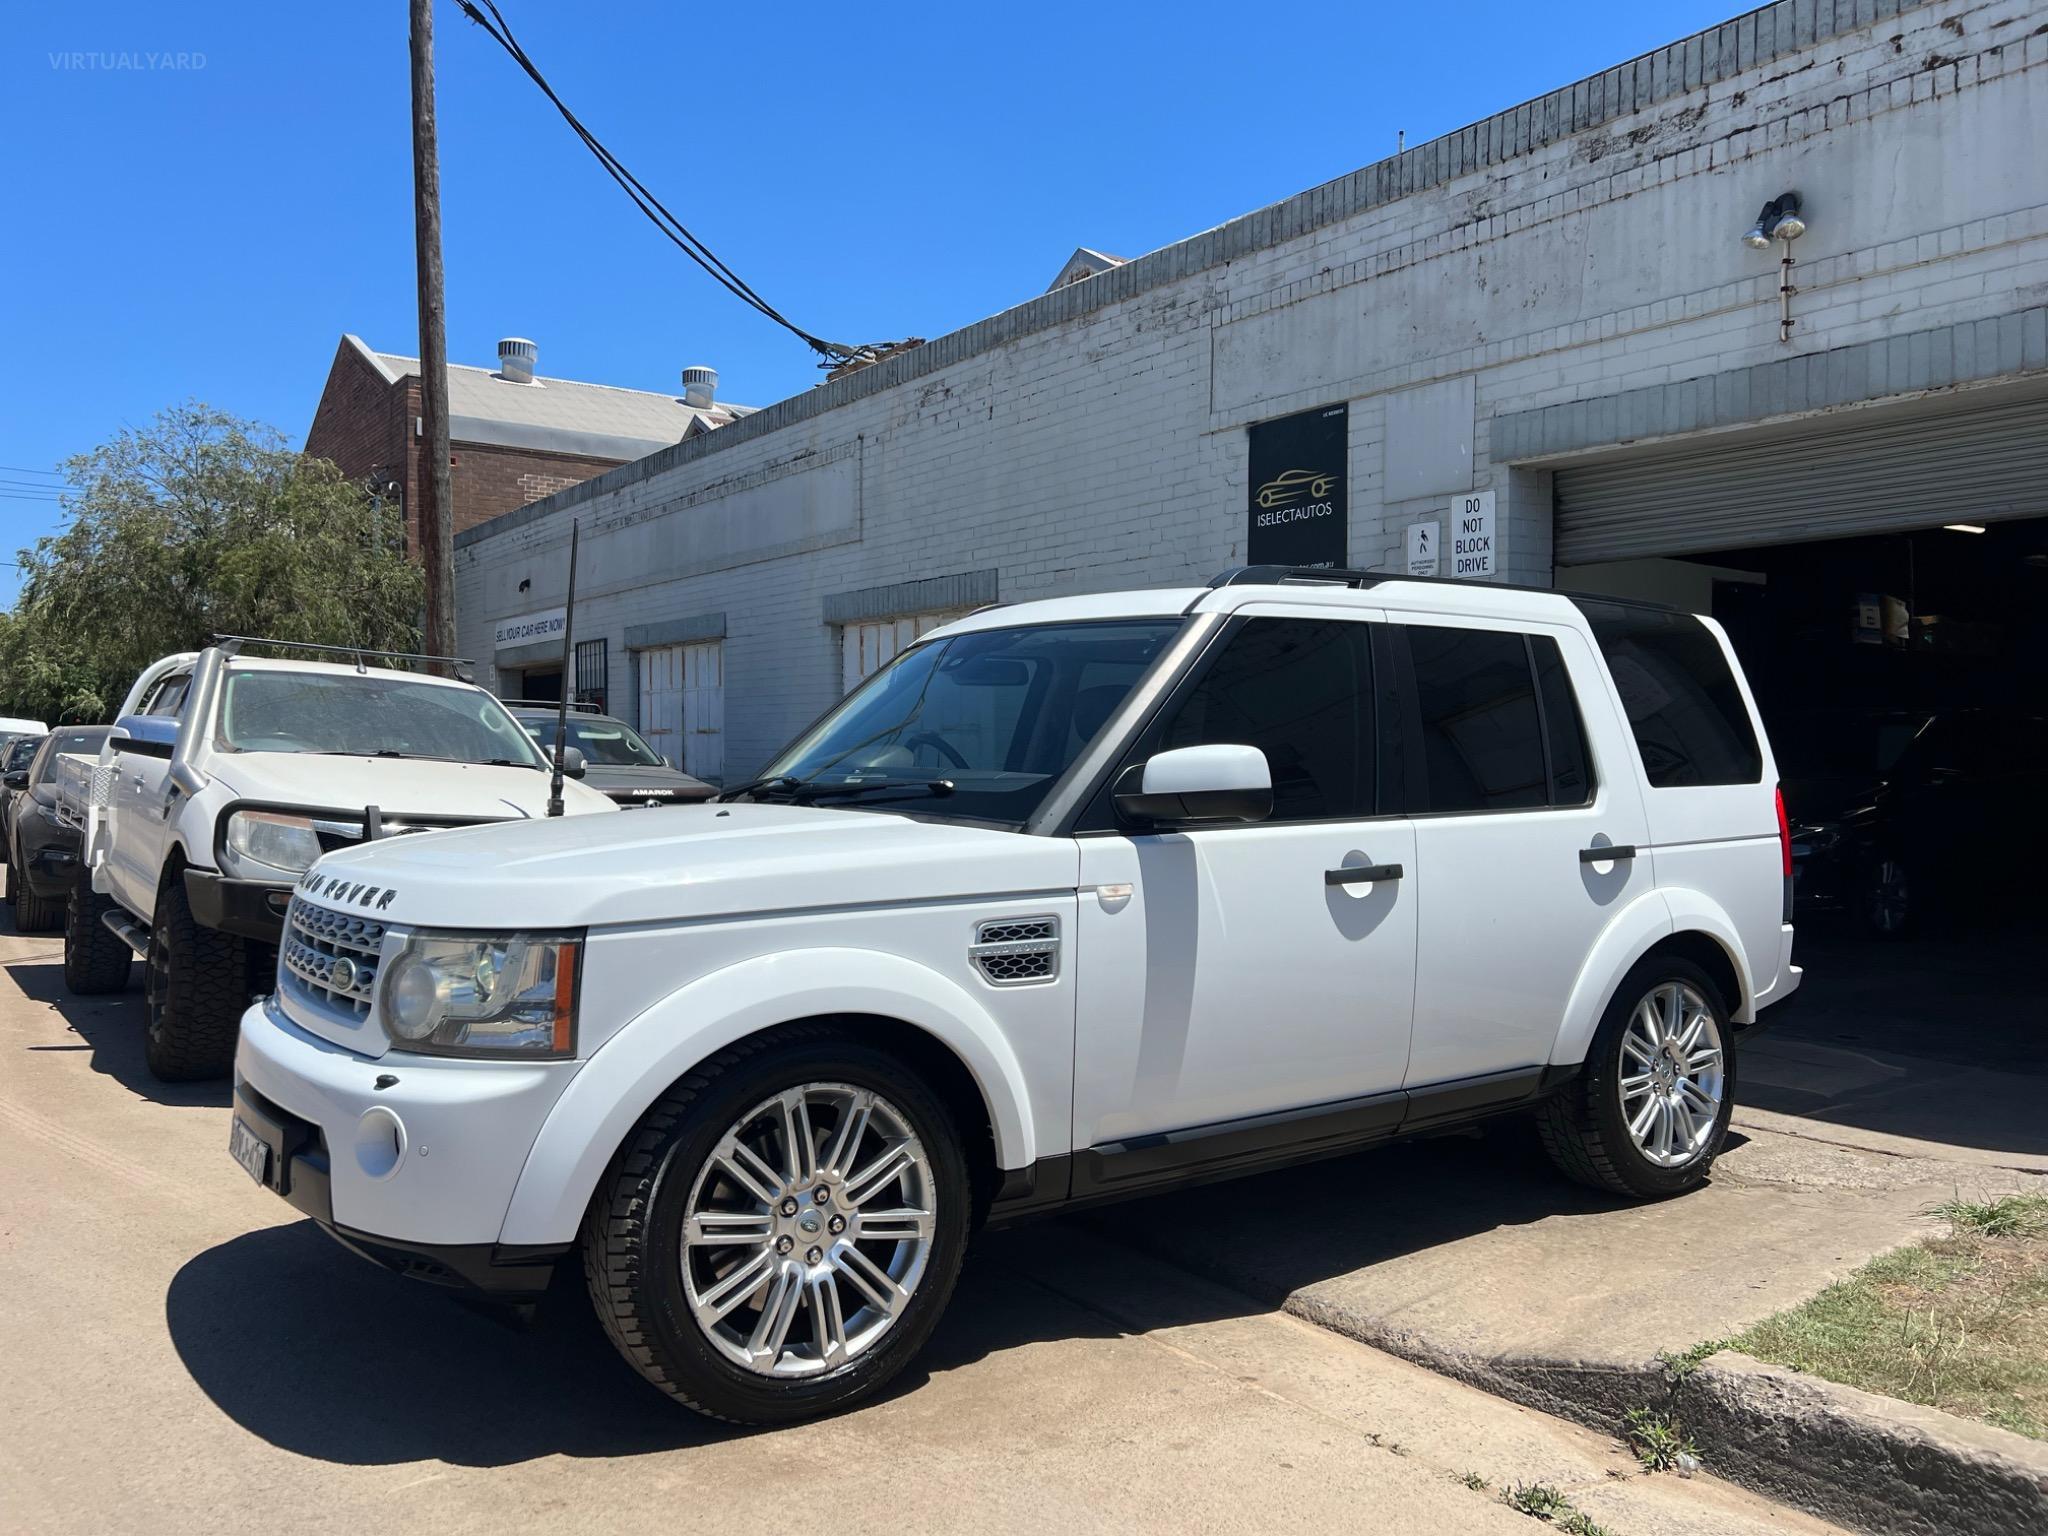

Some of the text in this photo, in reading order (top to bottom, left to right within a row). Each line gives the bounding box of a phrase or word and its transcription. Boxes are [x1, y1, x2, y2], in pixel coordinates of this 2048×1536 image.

[1257, 501, 1332, 527] ISELECTAUTOS
[1465, 498, 1480, 514] DO
[1463, 518, 1484, 534] NOT
[1455, 536, 1490, 554] BLOCK
[1457, 556, 1489, 573] DRIVE
[496, 630, 506, 642] SELL
[506, 626, 520, 640] YOUR
[521, 624, 534, 638] CAR
[534, 620, 549, 635] HERE
[632, 788, 675, 796] AMAROK
[322, 879, 398, 911] ROVER
